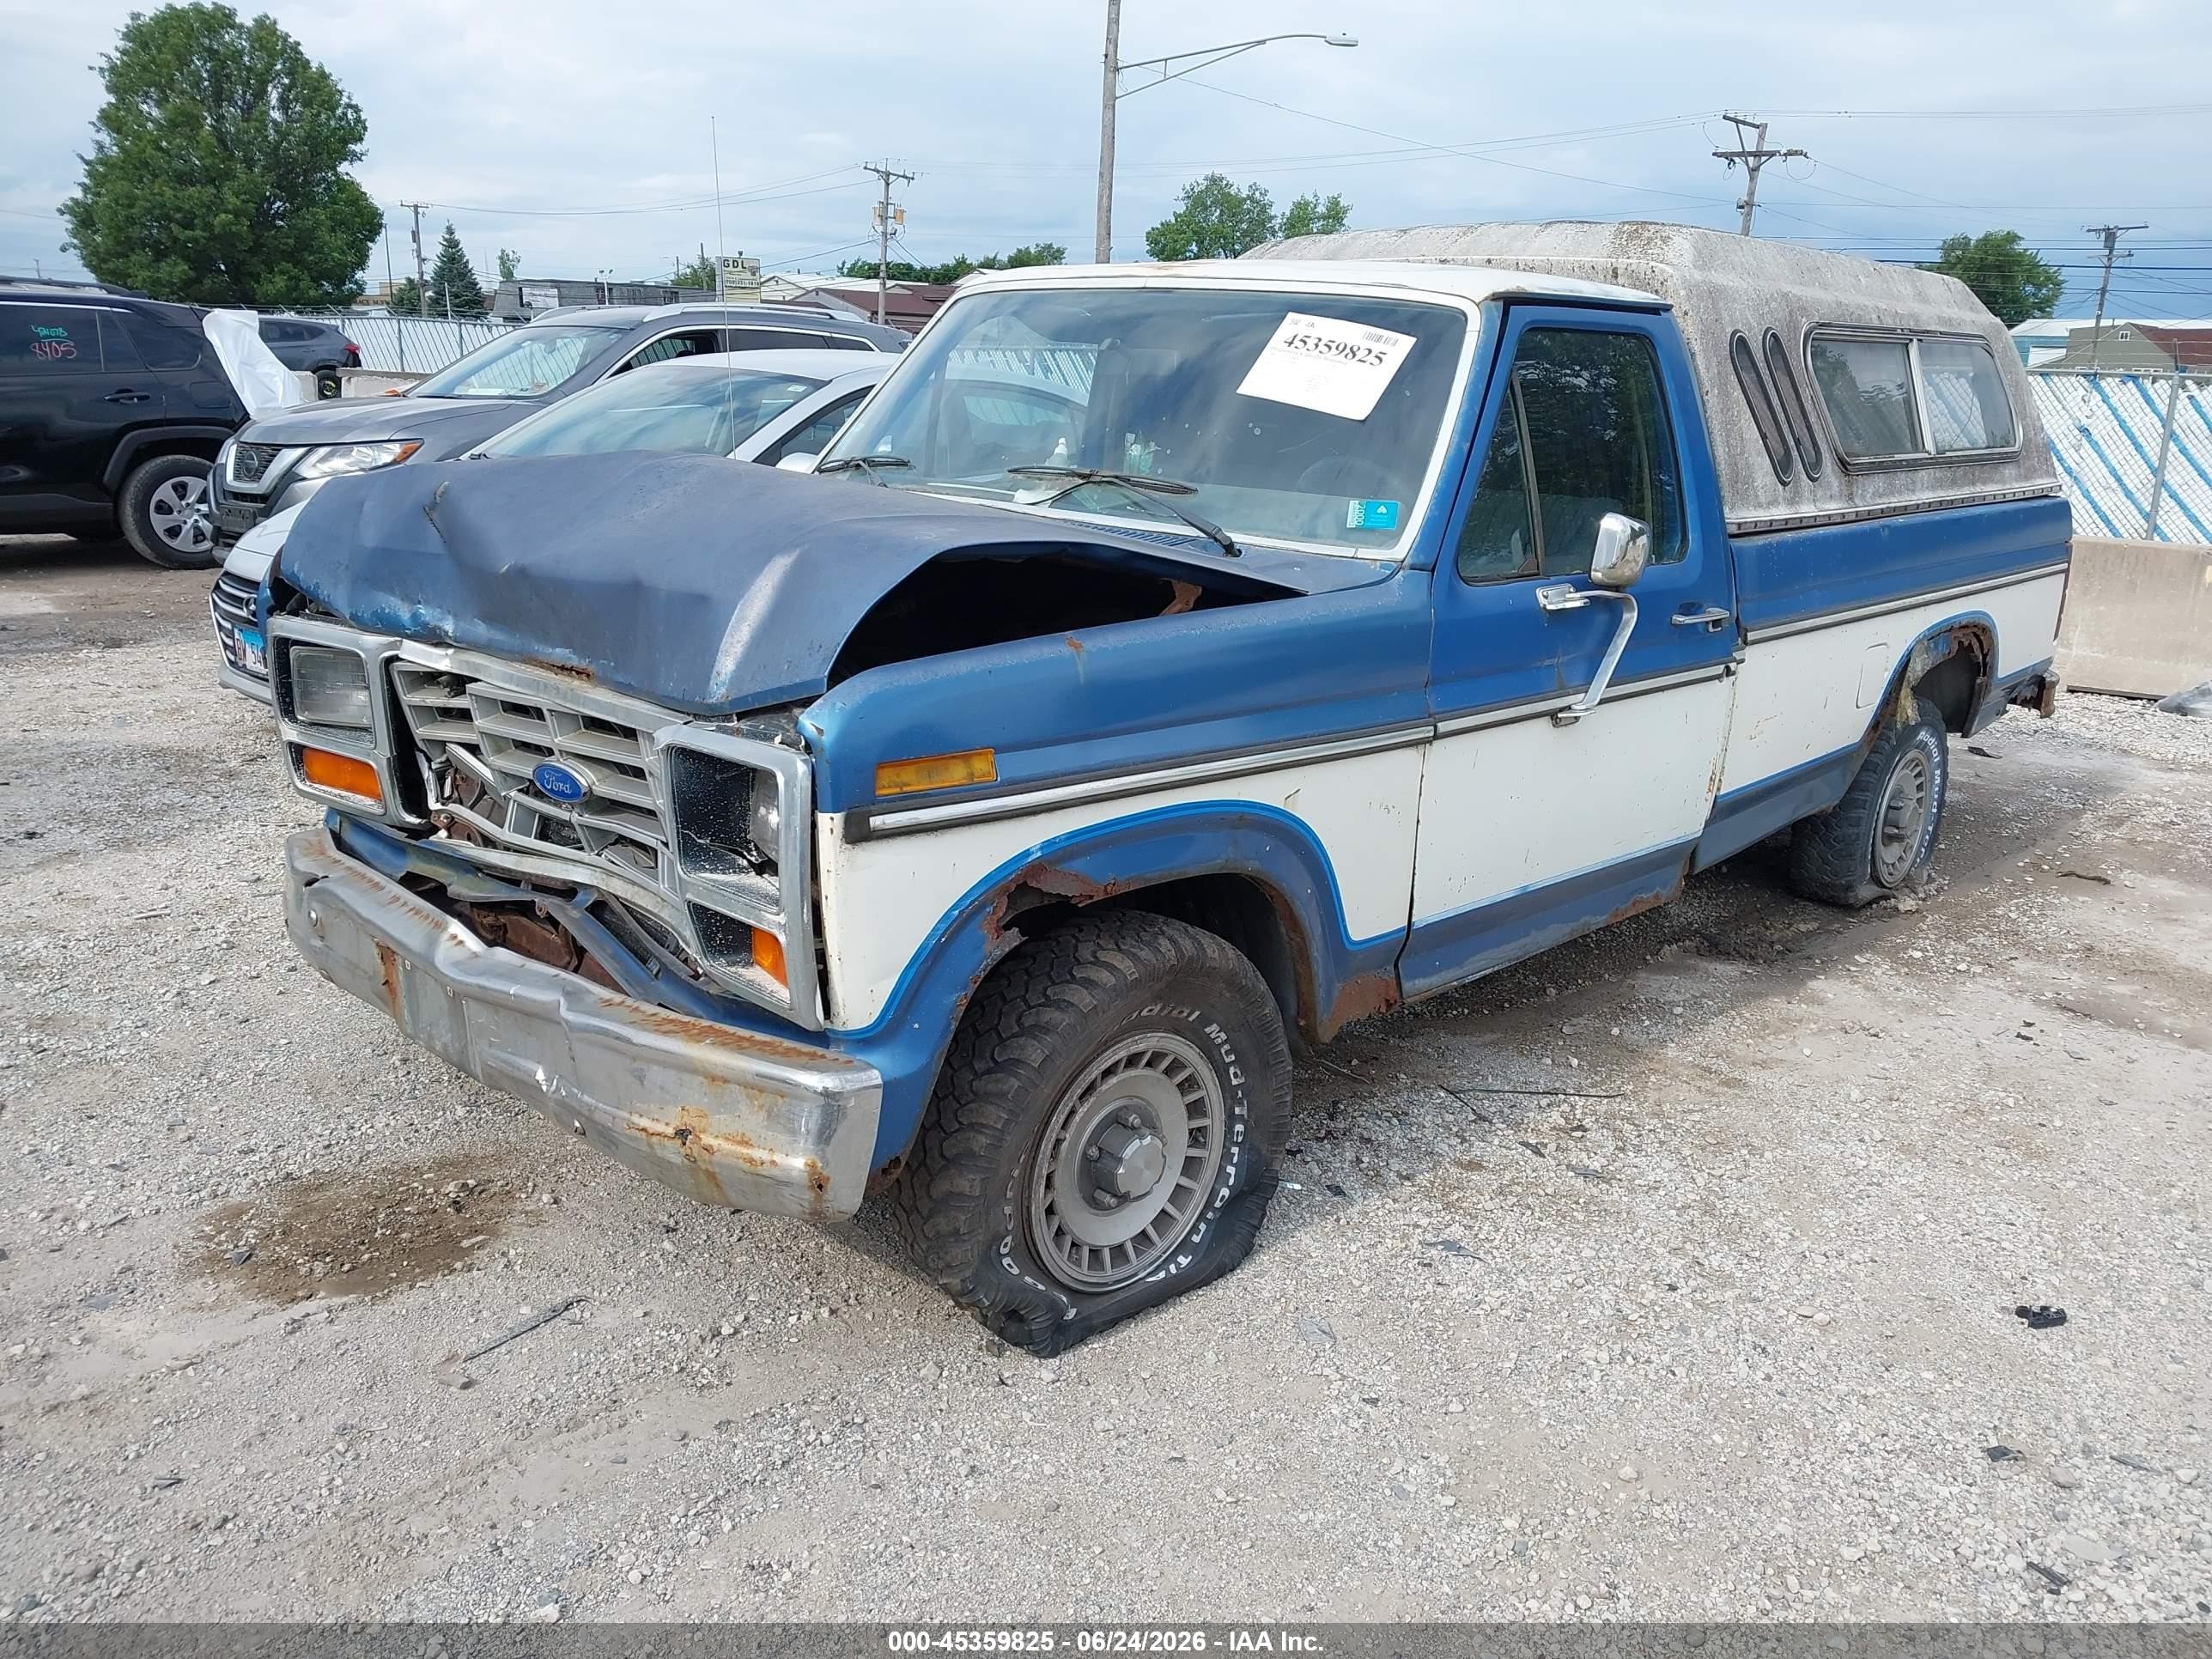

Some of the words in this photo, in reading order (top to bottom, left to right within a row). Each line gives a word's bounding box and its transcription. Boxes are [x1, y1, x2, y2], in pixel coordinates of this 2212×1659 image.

[723, 259, 747, 269] GDL
[1284, 333, 1388, 366] 45359825
[1916, 731, 1941, 763] Radial
[544, 770, 572, 794] Ford
[1911, 769, 1941, 868] Mud-Terr
[1115, 1002, 1201, 1032] adial
[1191, 1023, 1248, 1243] Mud-Terrain
